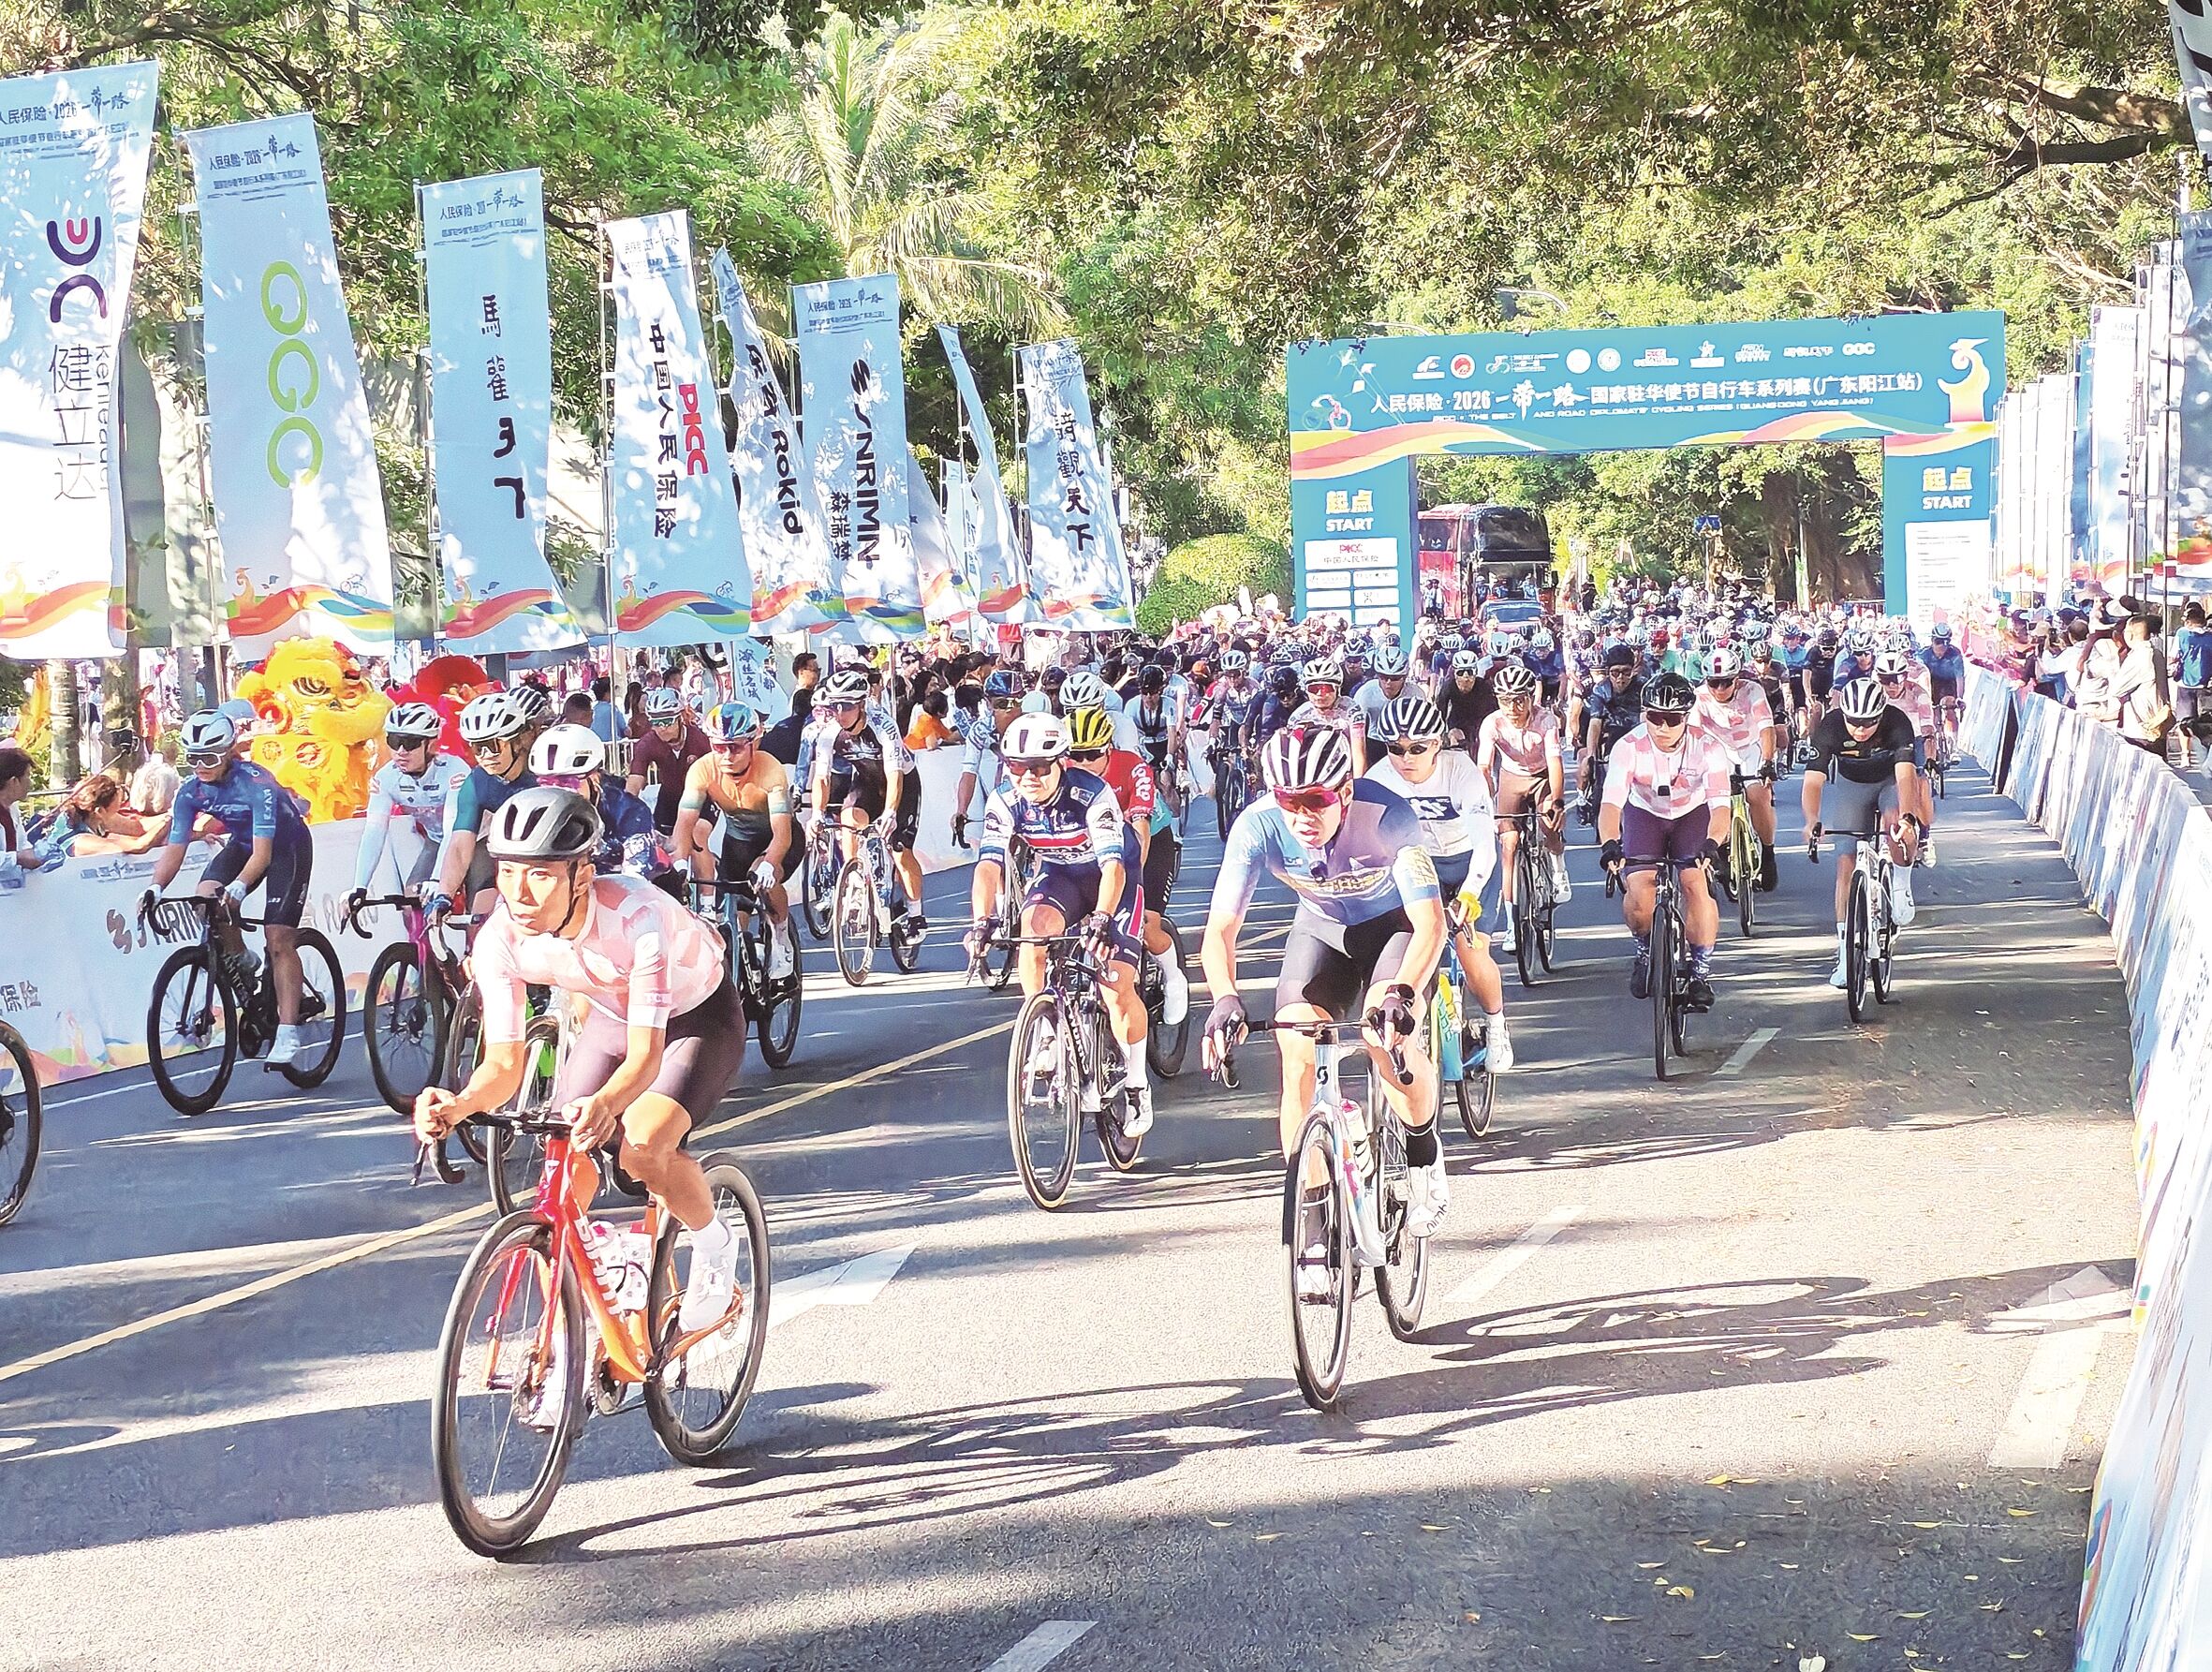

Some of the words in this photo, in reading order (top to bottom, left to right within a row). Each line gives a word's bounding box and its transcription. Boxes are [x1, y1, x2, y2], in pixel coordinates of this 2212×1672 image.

[48, 343, 97, 501] 健立达
[648, 323, 679, 540] 中国人民保险
[678, 382, 710, 476] PICC
[1325, 517, 1374, 532] START
[1922, 496, 1973, 510] START
